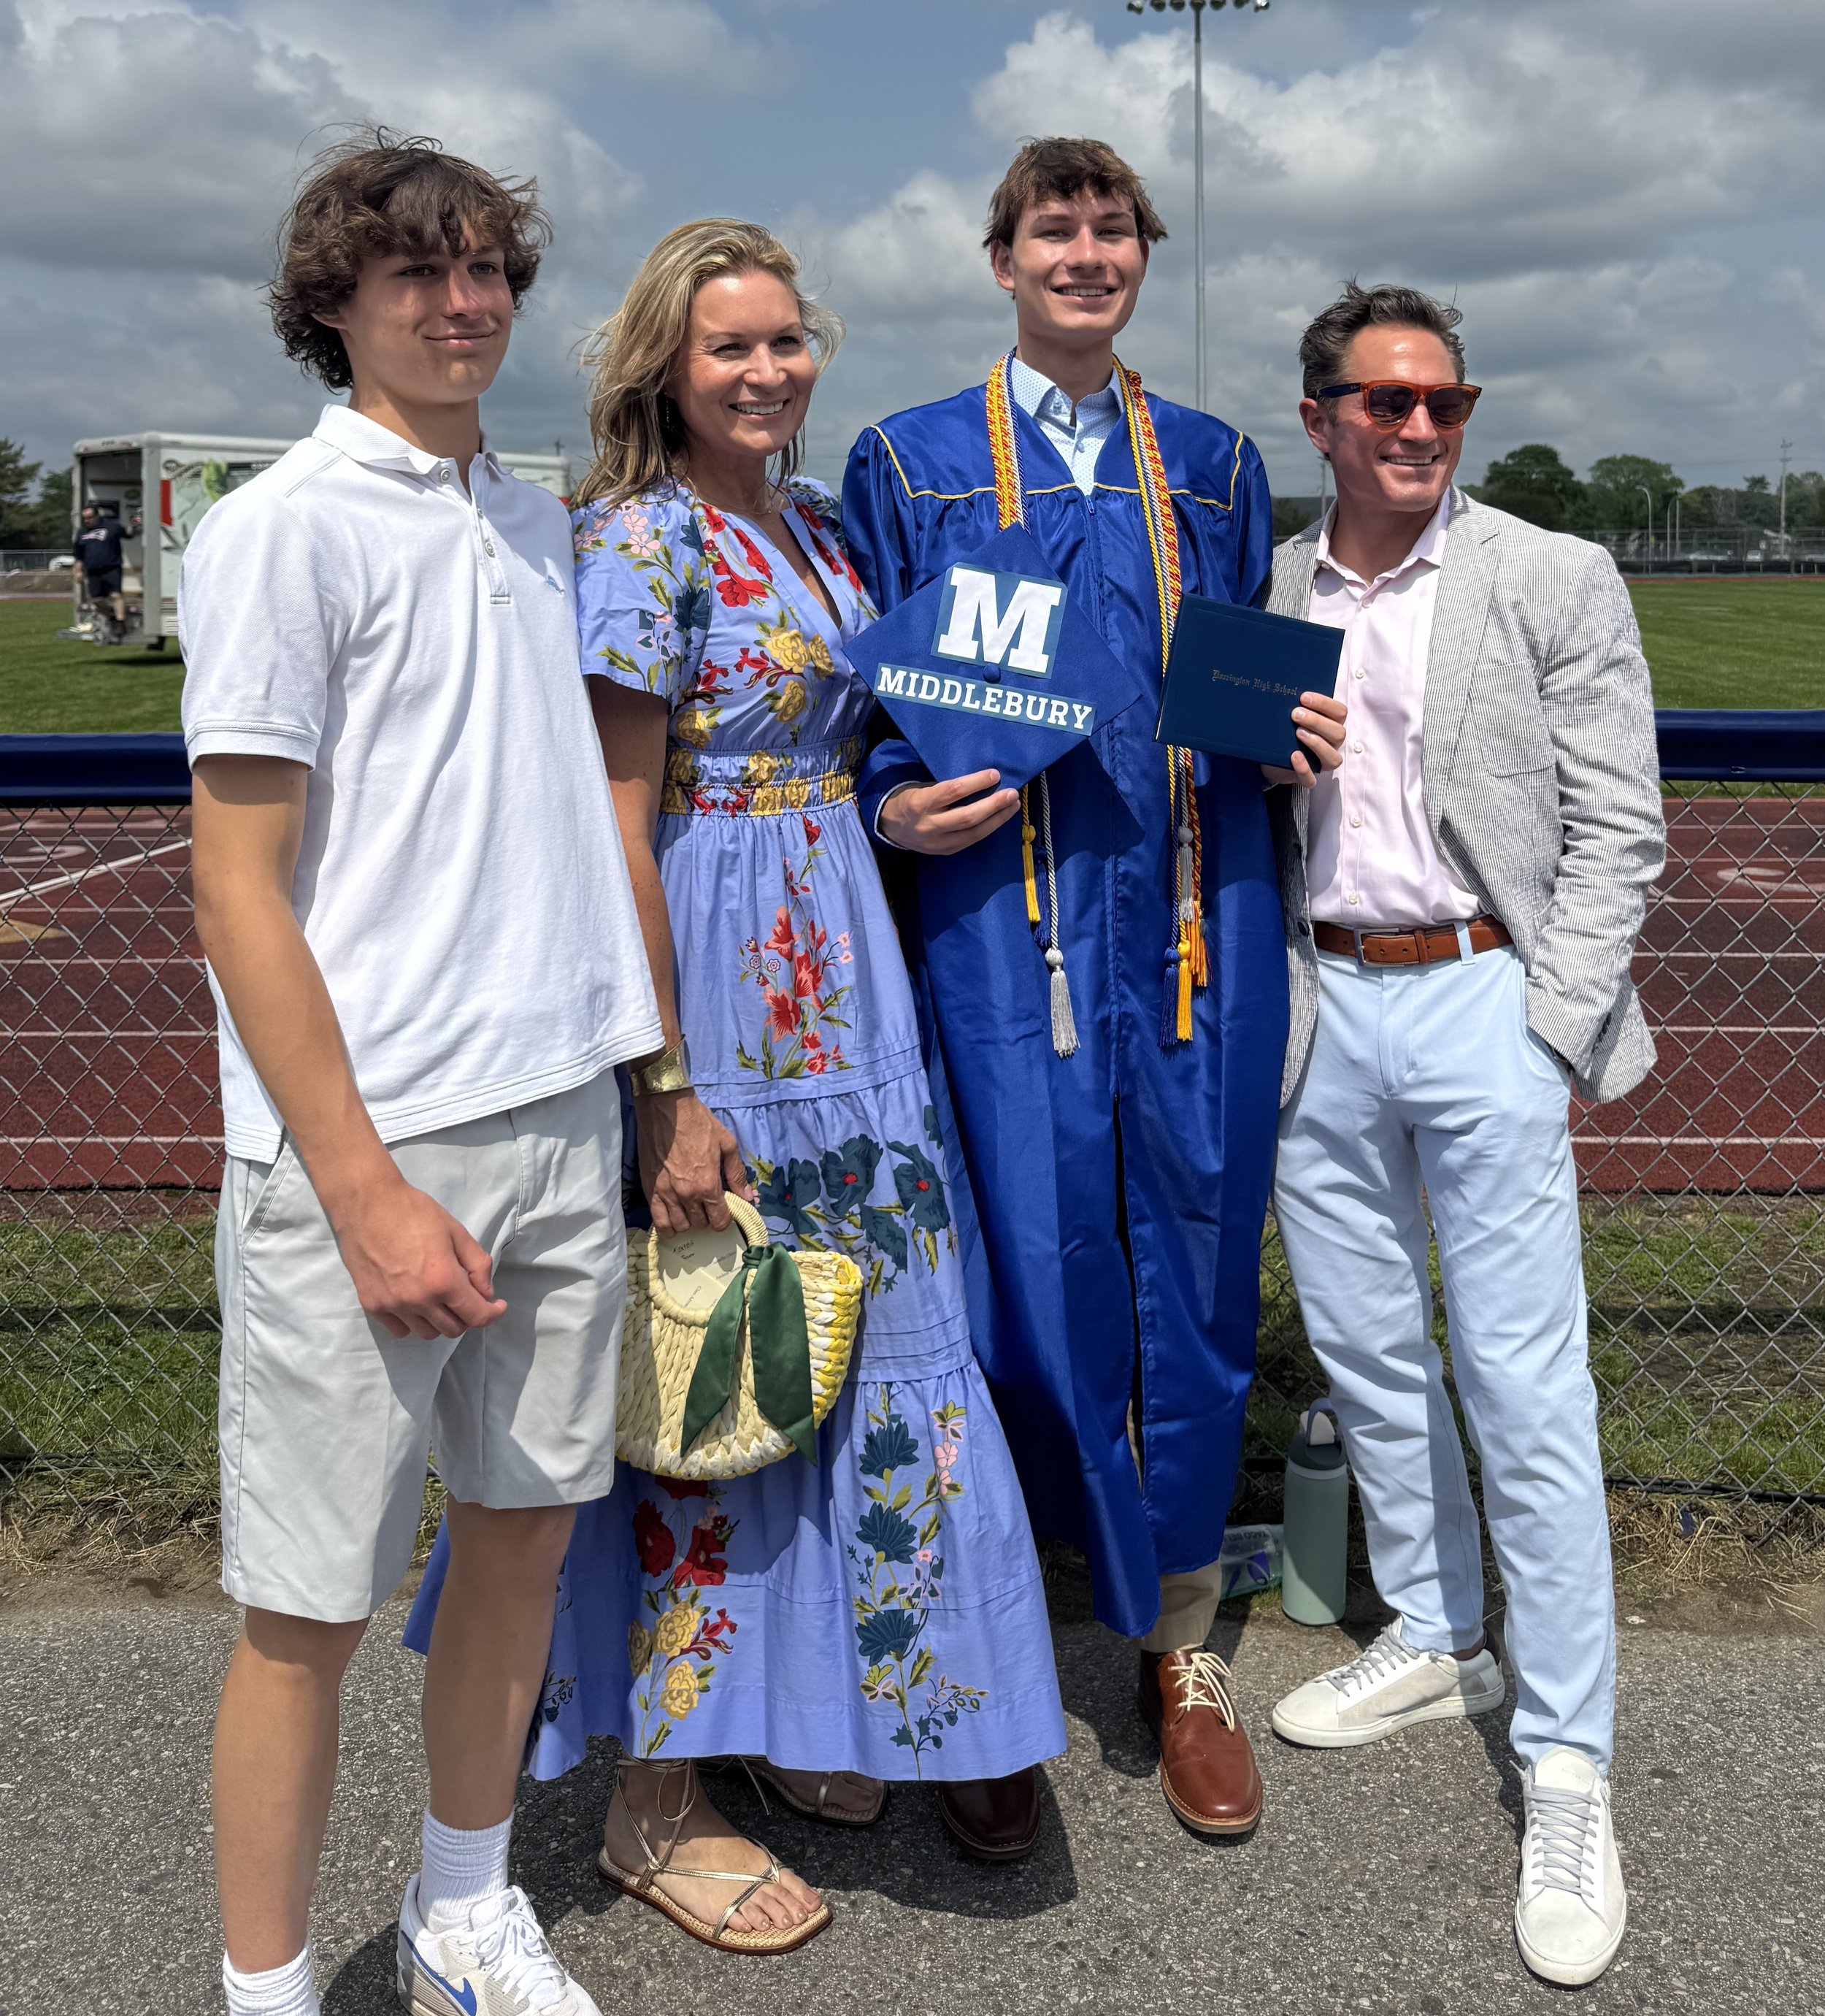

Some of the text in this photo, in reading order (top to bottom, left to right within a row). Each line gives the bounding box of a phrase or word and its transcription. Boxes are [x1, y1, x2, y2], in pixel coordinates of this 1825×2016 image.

[937, 567, 1062, 673] M
[877, 667, 1092, 729] MIDDLEBURY
[1253, 677, 1271, 692] High
[1272, 682, 1298, 696] School
